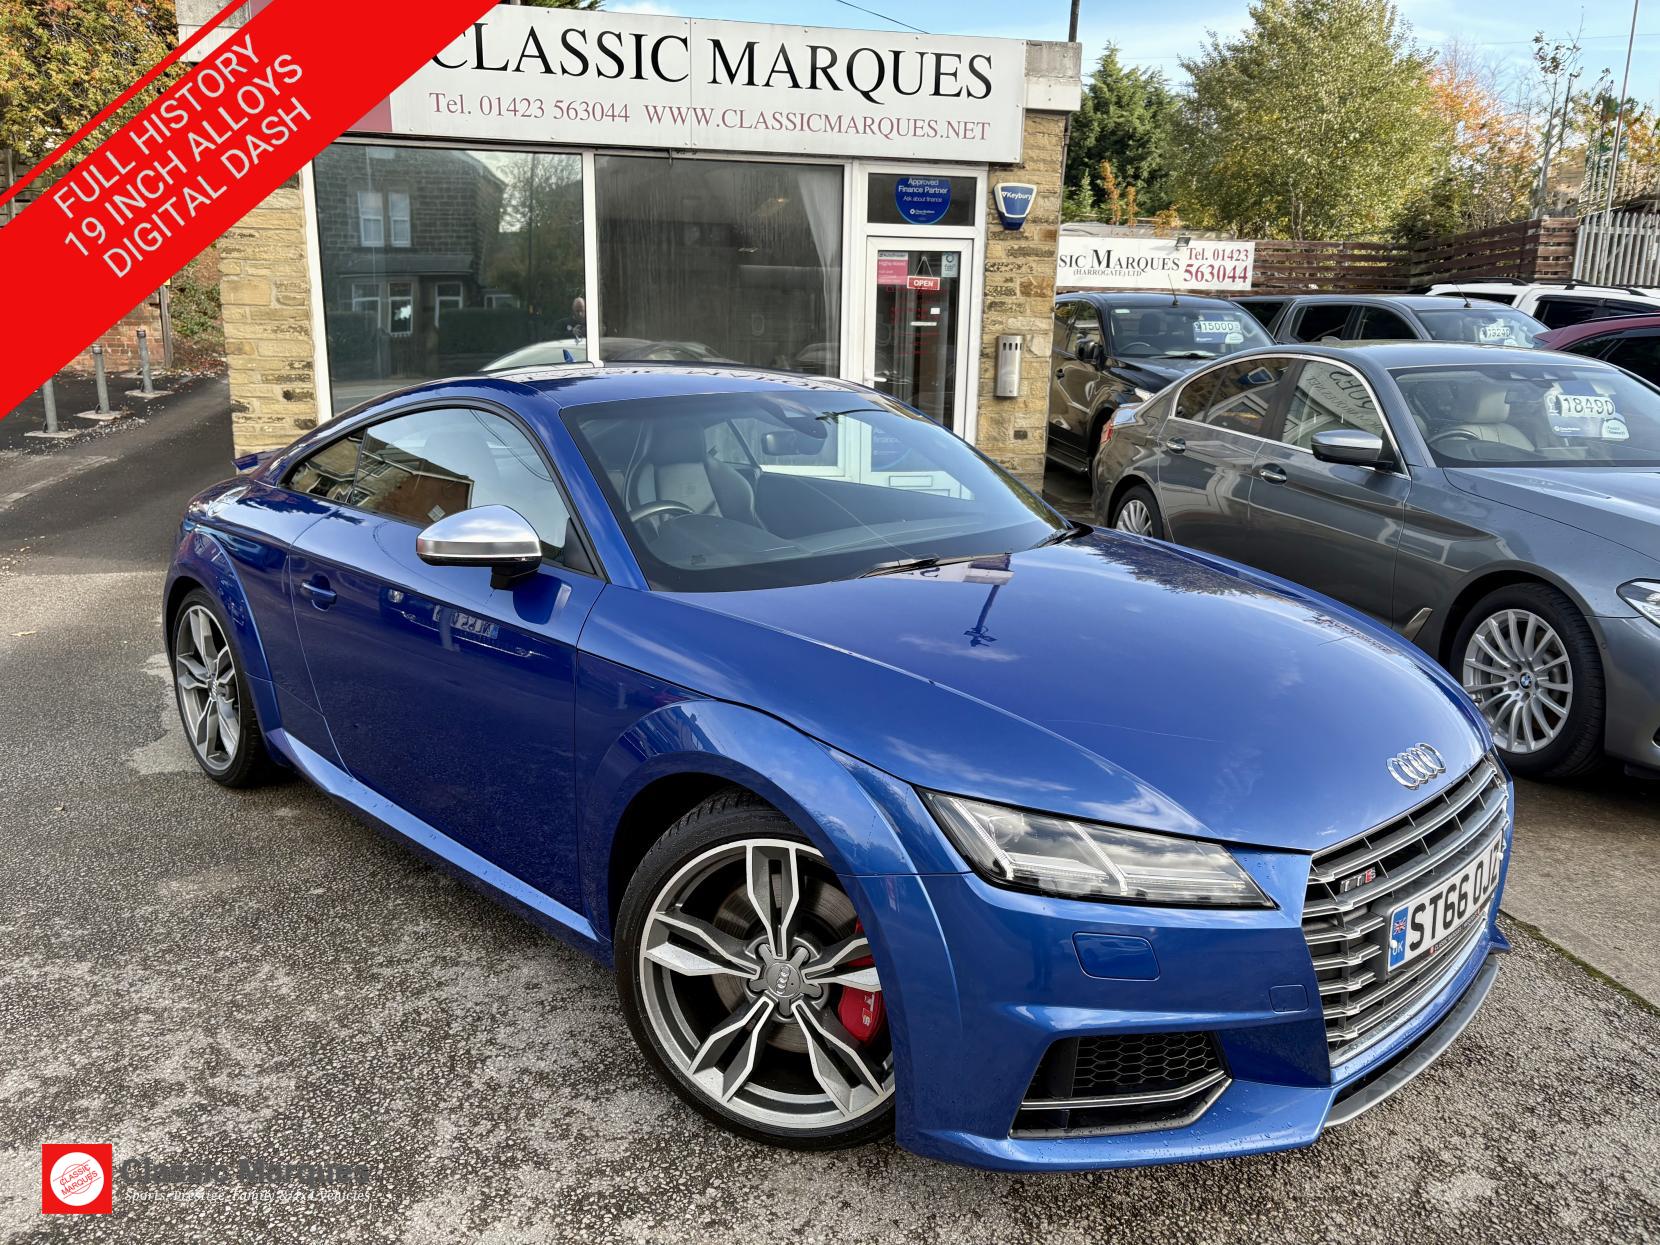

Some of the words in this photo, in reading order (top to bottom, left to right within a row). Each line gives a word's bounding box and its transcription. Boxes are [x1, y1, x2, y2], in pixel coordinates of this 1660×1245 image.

[707, 38, 993, 105] MARQUES
[429, 92, 472, 115] Tel.
[479, 95, 545, 119] 01423
[553, 100, 630, 123] 563044
[644, 103, 991, 141] WWW.CLASSICMARQUES.NET
[898, 185, 923, 194] Finance
[924, 186, 949, 195] Partner
[908, 178, 939, 187] Approved
[1090, 249, 1181, 273] MARQUES
[1186, 247, 1209, 261] Tel.
[1212, 248, 1249, 262] 01423
[913, 279, 934, 287] OPEN
[1073, 269, 1126, 278] (HARROGATE)
[1183, 263, 1248, 284] 563044
[1409, 873, 1470, 952] ST66
